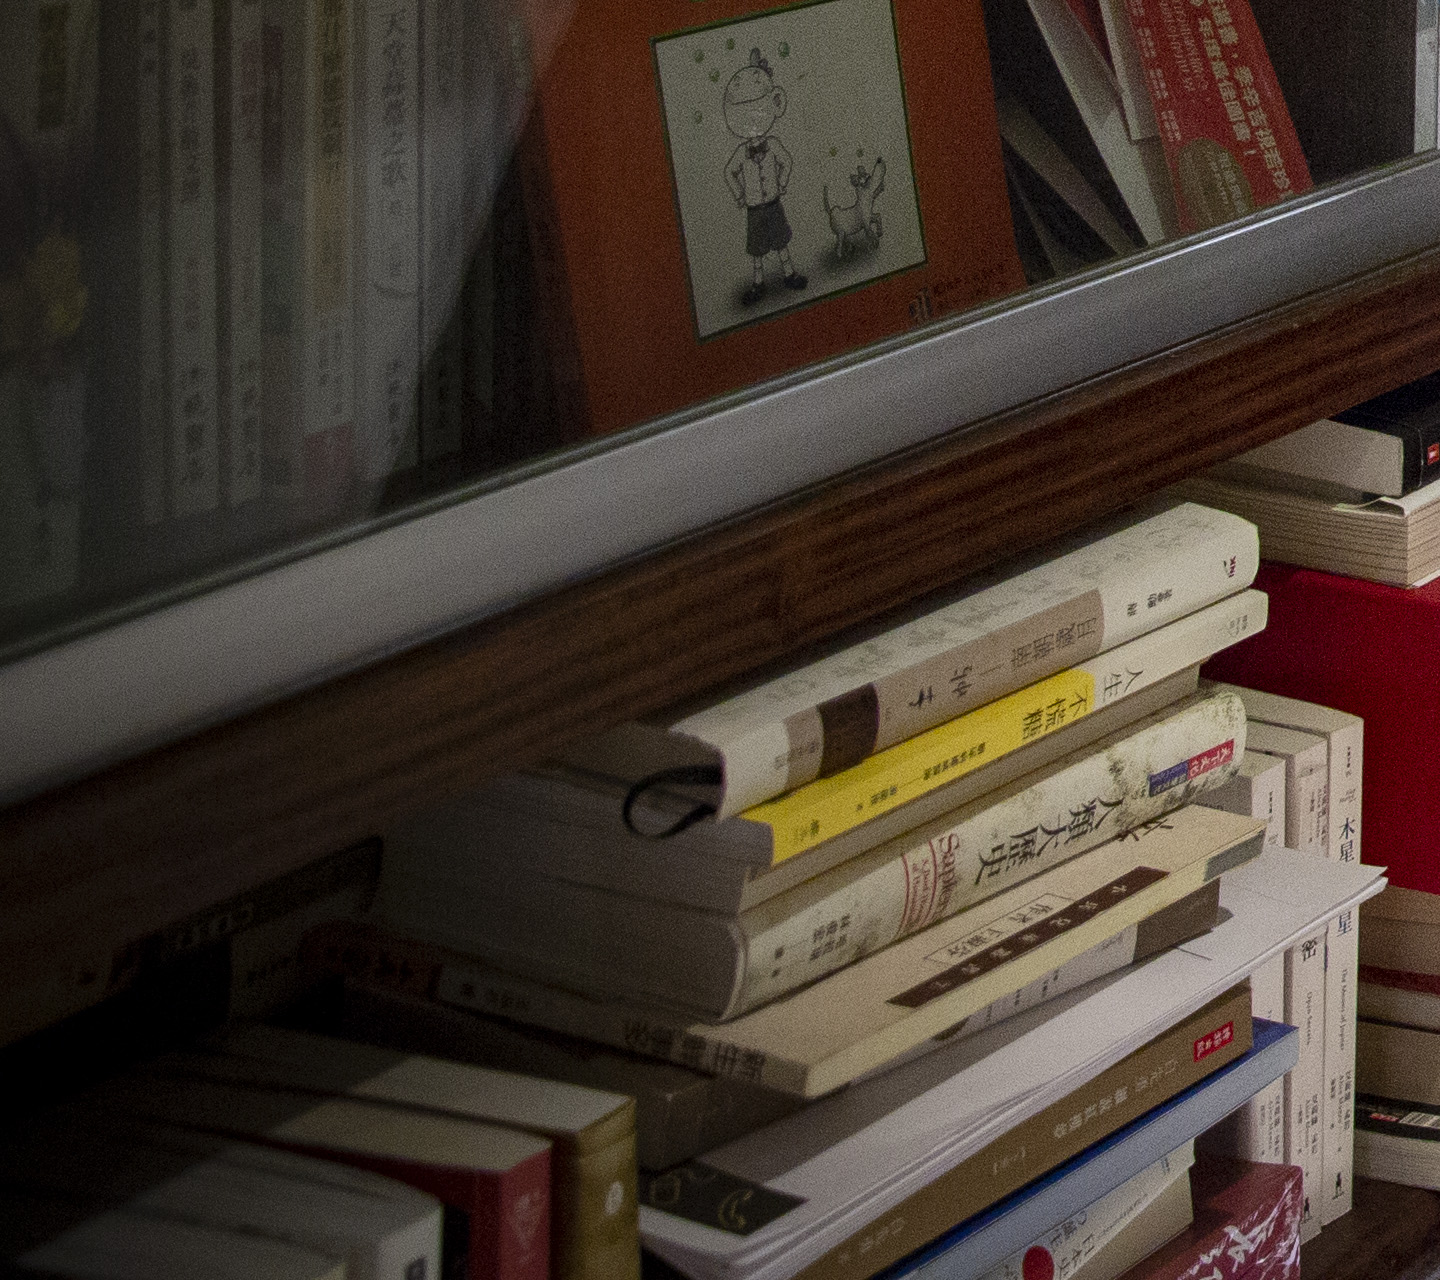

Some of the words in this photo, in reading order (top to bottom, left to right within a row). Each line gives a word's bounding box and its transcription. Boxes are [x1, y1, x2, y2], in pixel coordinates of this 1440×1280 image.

[977, 795, 1123, 886] 人類大歷史
